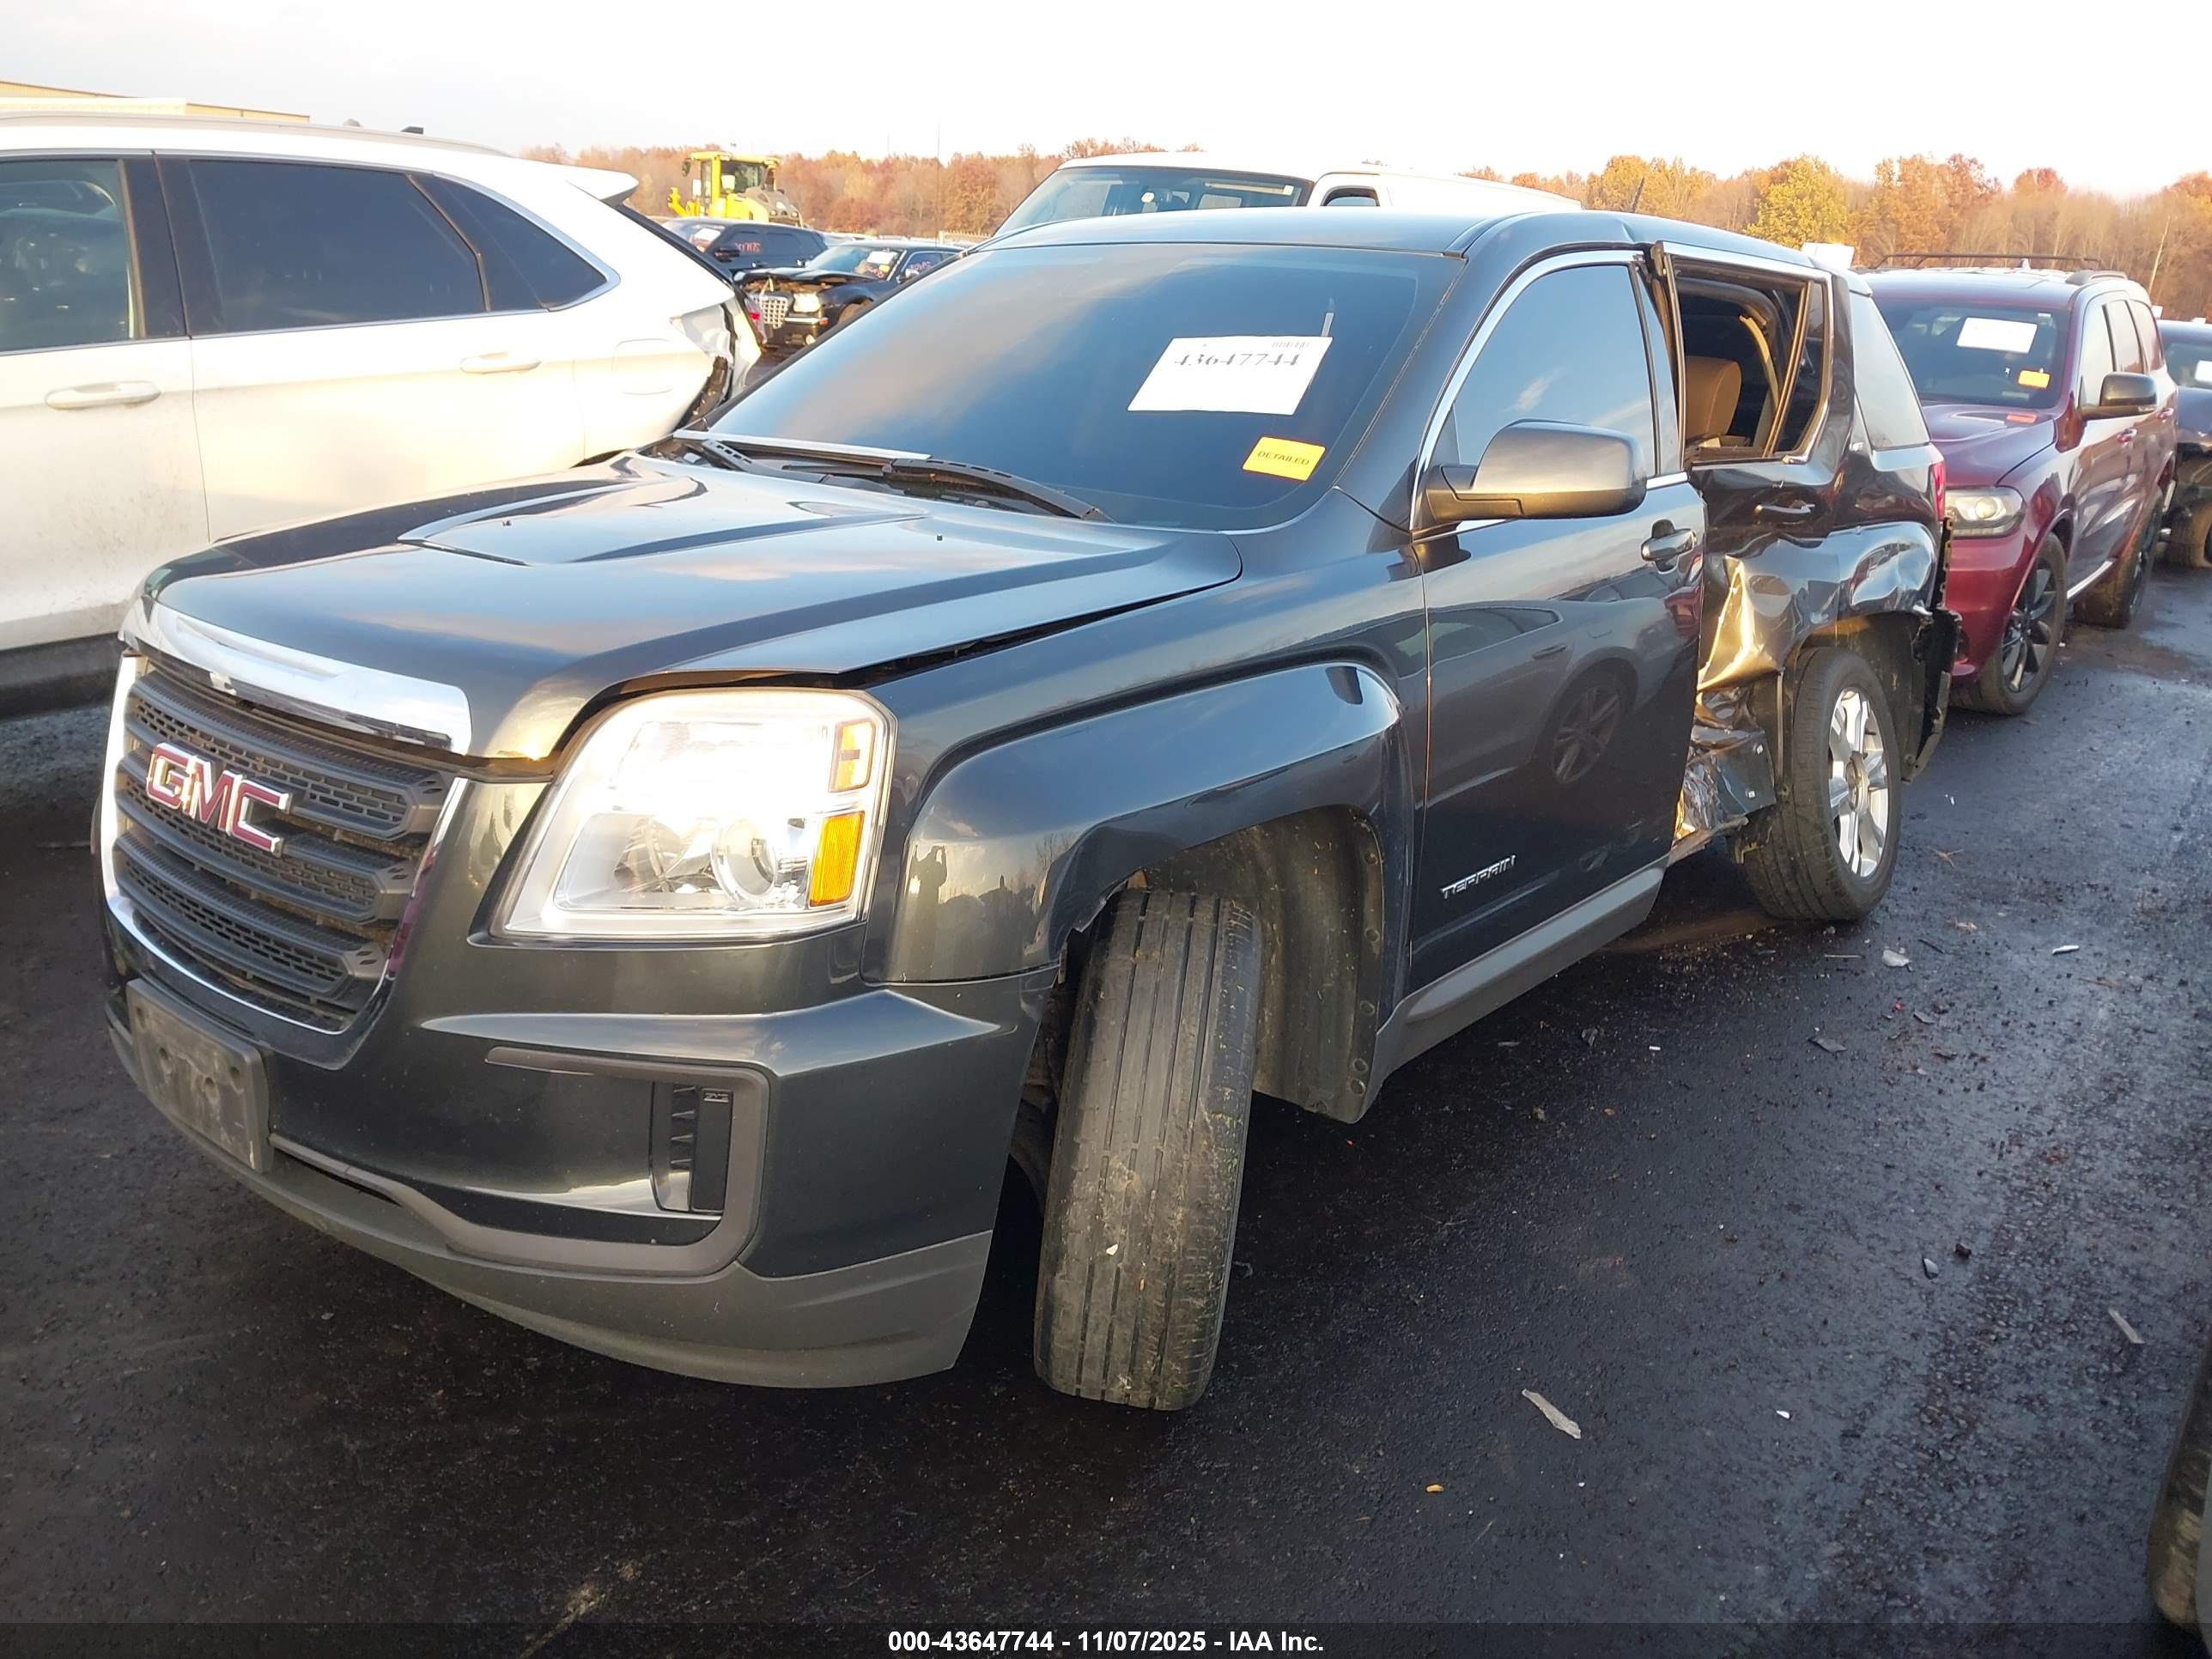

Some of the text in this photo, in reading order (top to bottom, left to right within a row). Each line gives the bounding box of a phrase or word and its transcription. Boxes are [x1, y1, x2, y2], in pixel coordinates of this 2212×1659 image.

[1257, 450, 1310, 465] DETAILED
[146, 743, 290, 854] GMC
[1440, 854, 1516, 900] TERRAIN
